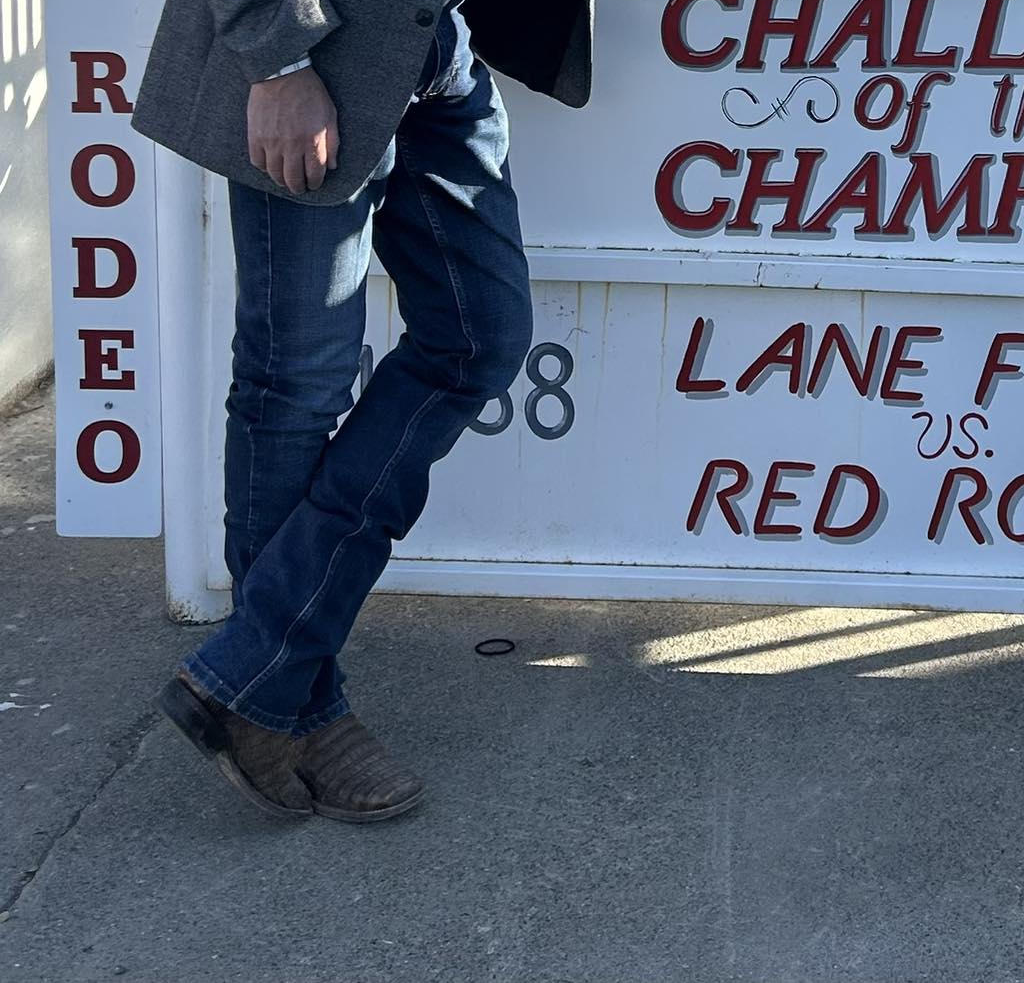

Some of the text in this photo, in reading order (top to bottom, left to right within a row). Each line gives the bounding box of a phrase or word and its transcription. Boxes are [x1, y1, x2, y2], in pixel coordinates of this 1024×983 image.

[853, 71, 953, 156] of
[70, 51, 141, 484] RODEO
[676, 317, 943, 407] LANE
[685, 458, 889, 542] RED
